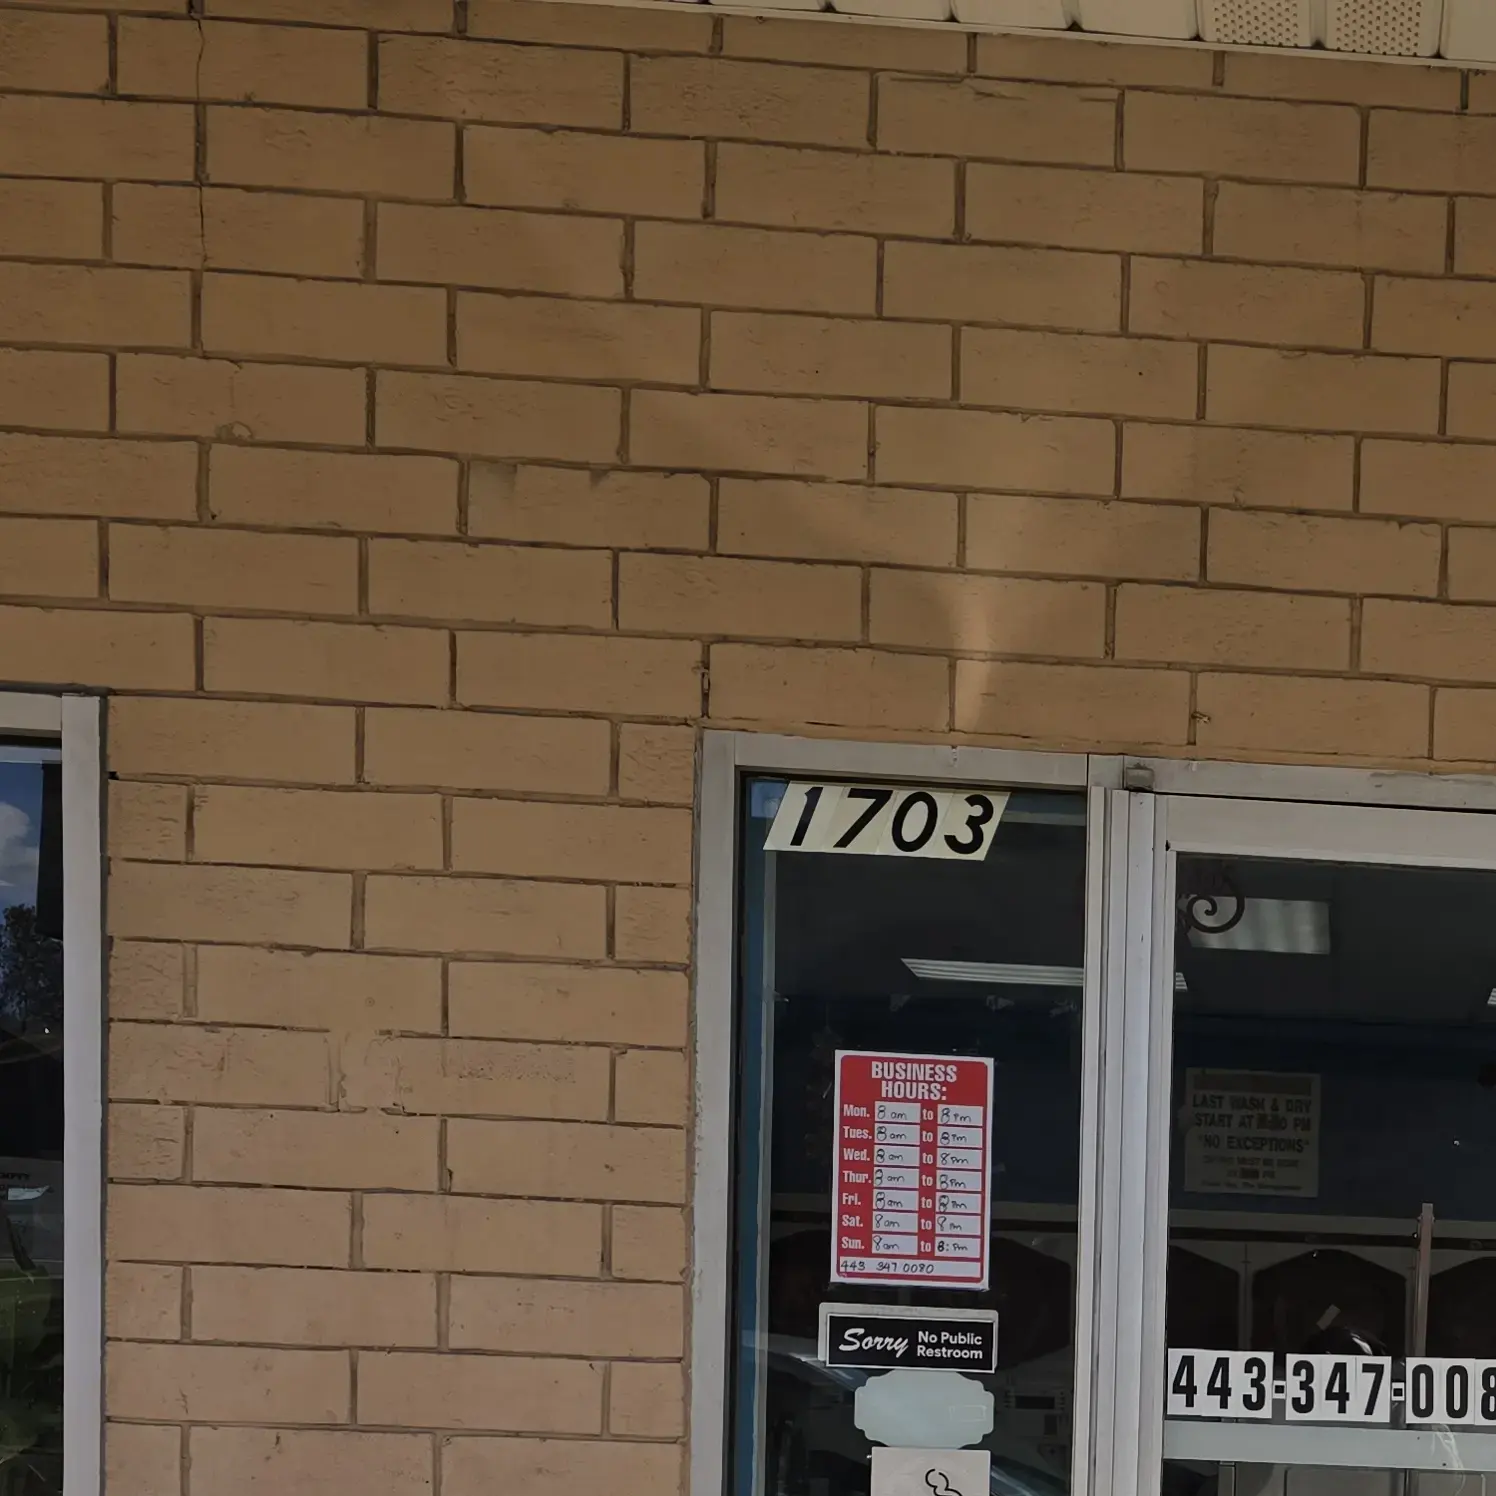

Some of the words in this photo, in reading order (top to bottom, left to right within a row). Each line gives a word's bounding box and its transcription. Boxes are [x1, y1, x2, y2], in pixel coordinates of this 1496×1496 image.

[790, 786, 995, 855] 1703
[872, 1061, 957, 1082] BUSINESS
[881, 1081, 947, 1101] HOURS:
[1192, 1094, 1224, 1109] LAST
[1229, 1095, 1266, 1112] WASH
[1286, 1099, 1312, 1113] DRY
[843, 1104, 870, 1118] Mon.
[922, 1109, 934, 1121] to
[1194, 1113, 1233, 1128] START
[1238, 1115, 1254, 1129] AT
[1293, 1117, 1311, 1131] PM
[842, 1126, 872, 1139] Tues.
[922, 1130, 933, 1142] to
[843, 1148, 870, 1161] Wed.
[922, 1152, 933, 1164] to
[842, 1170, 872, 1183] Thur.
[921, 1174, 933, 1186] to
[842, 1193, 861, 1206] Fri.
[921, 1197, 932, 1209] to
[841, 1214, 864, 1227] Sat.
[920, 1219, 932, 1230] to
[841, 1236, 865, 1249] Sun.
[920, 1240, 932, 1252] to
[841, 1260, 865, 1273] 443
[876, 1262, 897, 1272] 347
[903, 1263, 935, 1274] 0080
[838, 1328, 909, 1358] Sorry
[918, 1331, 938, 1344] No
[941, 1332, 983, 1345] Public
[917, 1345, 983, 1359] Restroom
